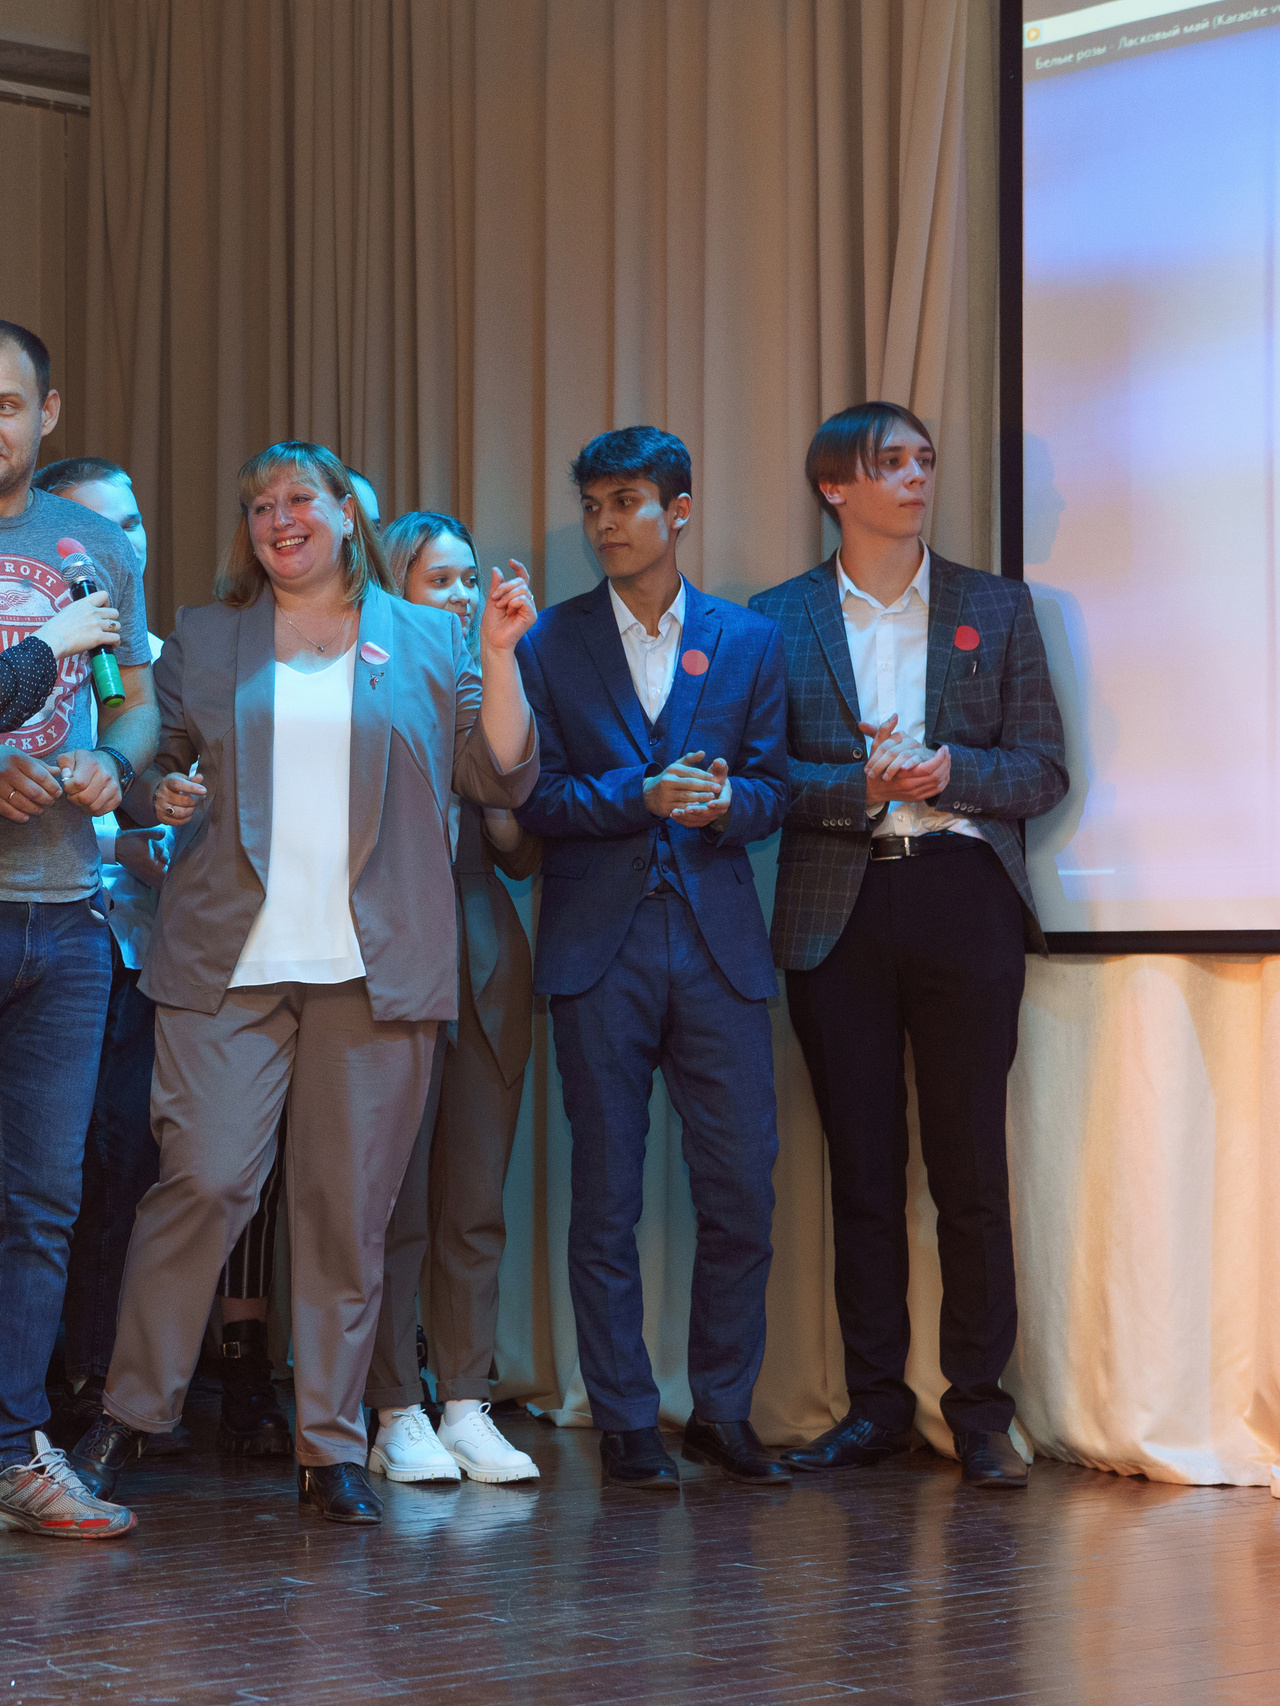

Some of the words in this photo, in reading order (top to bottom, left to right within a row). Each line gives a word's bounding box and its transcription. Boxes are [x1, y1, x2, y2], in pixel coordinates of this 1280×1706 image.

[1035, 53, 1074, 70] Белые
[1076, 45, 1107, 63] розы
[1117, 25, 1180, 51] Ласковый
[1183, 17, 1210, 34] май
[1212, 6, 1268, 29] (Karaoke
